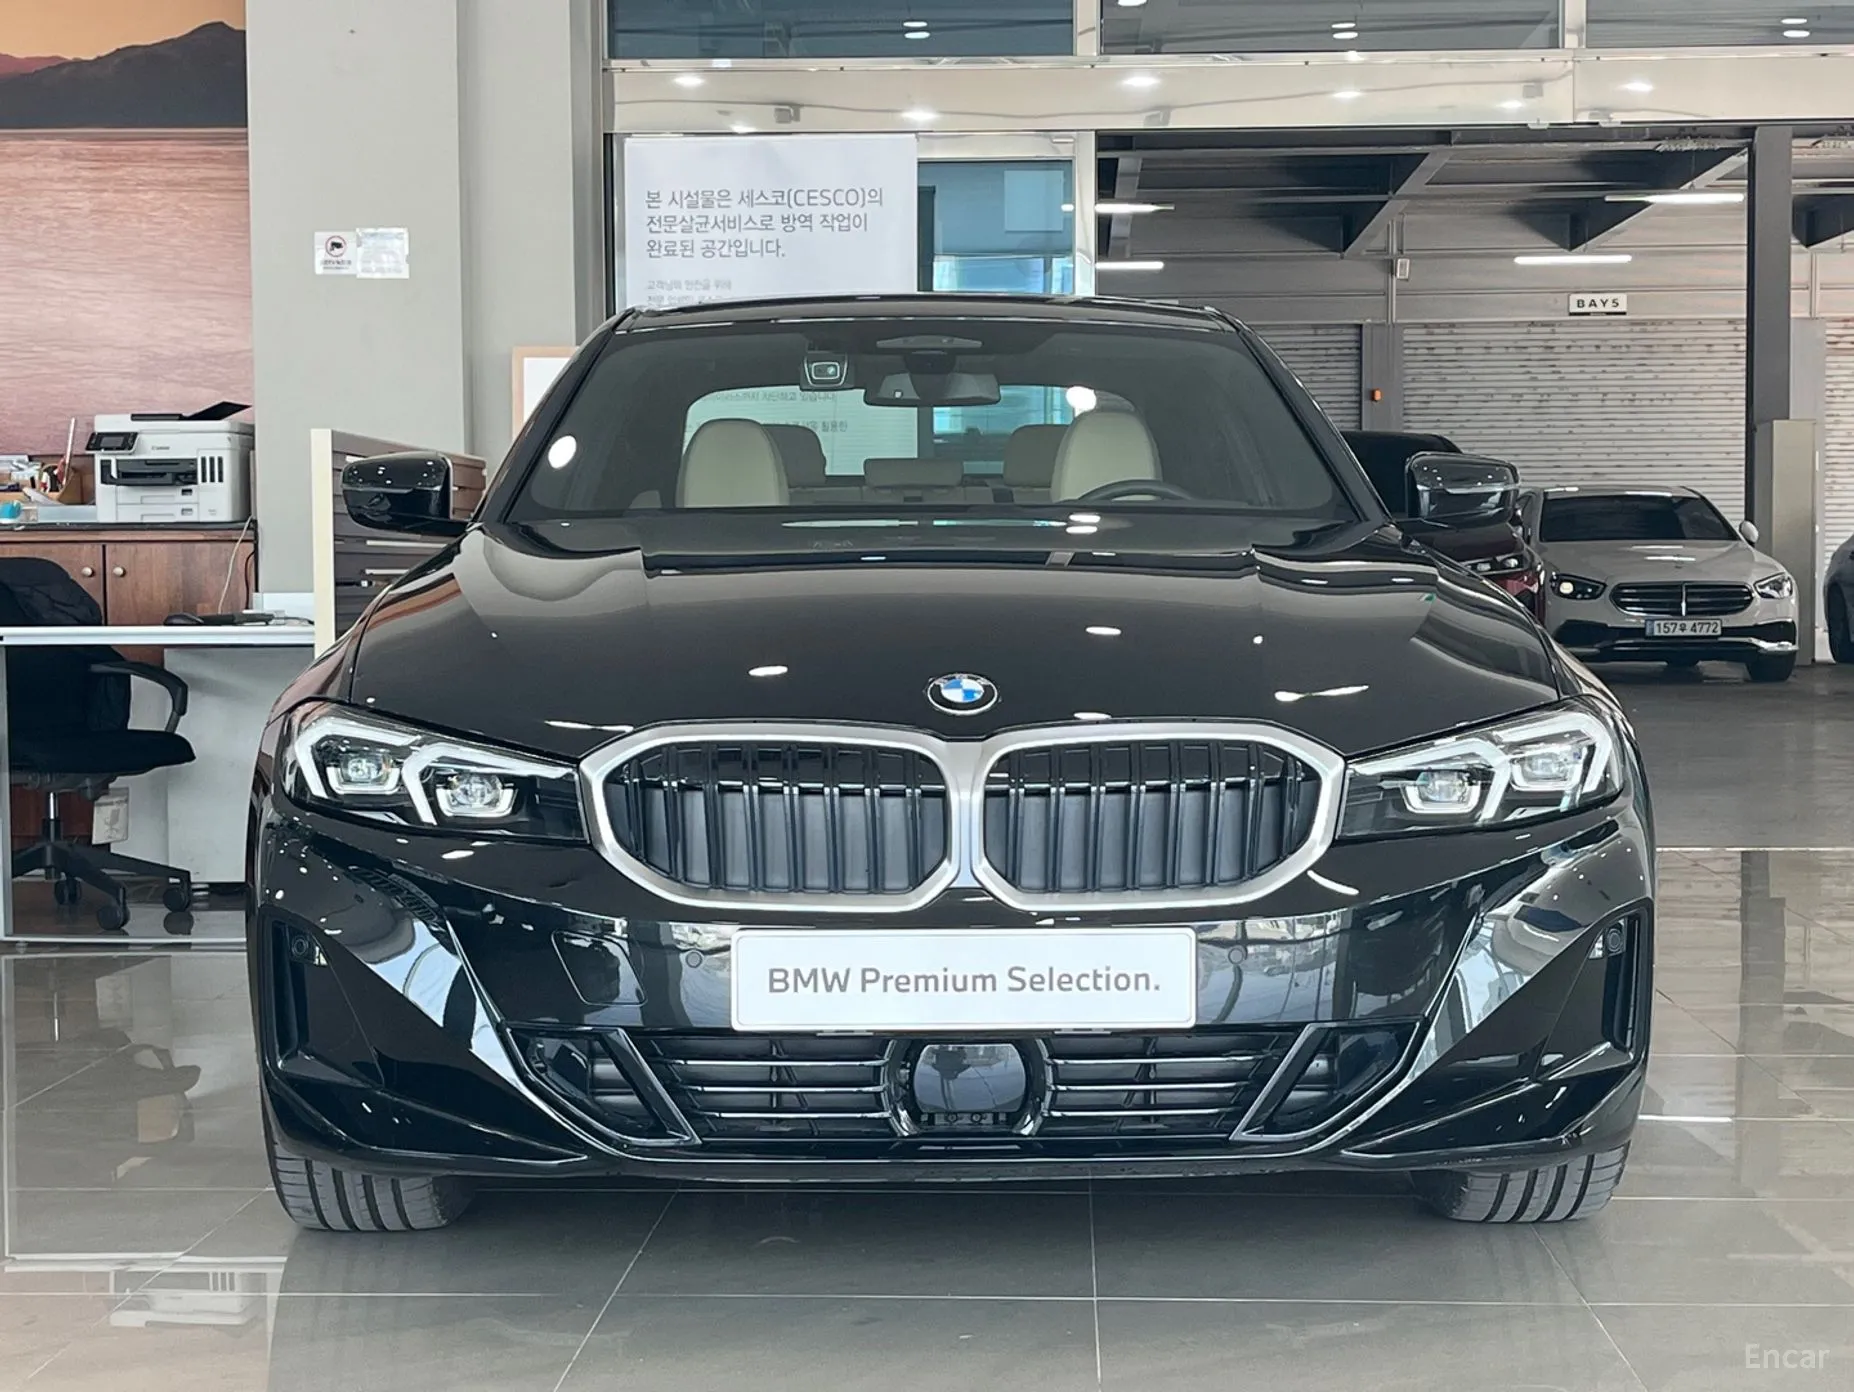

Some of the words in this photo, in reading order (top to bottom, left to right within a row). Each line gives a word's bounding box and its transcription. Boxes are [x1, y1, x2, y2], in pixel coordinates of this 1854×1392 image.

[645, 190, 663, 209] 본
[668, 189, 732, 209] 시설물은
[738, 188, 883, 208] 세스코(CESCO)의
[646, 214, 775, 234] 전문살균서비스로
[781, 213, 813, 233] 방역
[819, 212, 868, 233] 작업이
[646, 239, 694, 259] 완료된
[700, 238, 785, 259] 공간입니다.
[1690, 622, 1719, 634] 4772
[768, 967, 851, 993] BMW
[860, 967, 997, 993] Premium
[1007, 965, 1160, 992] Selection.
